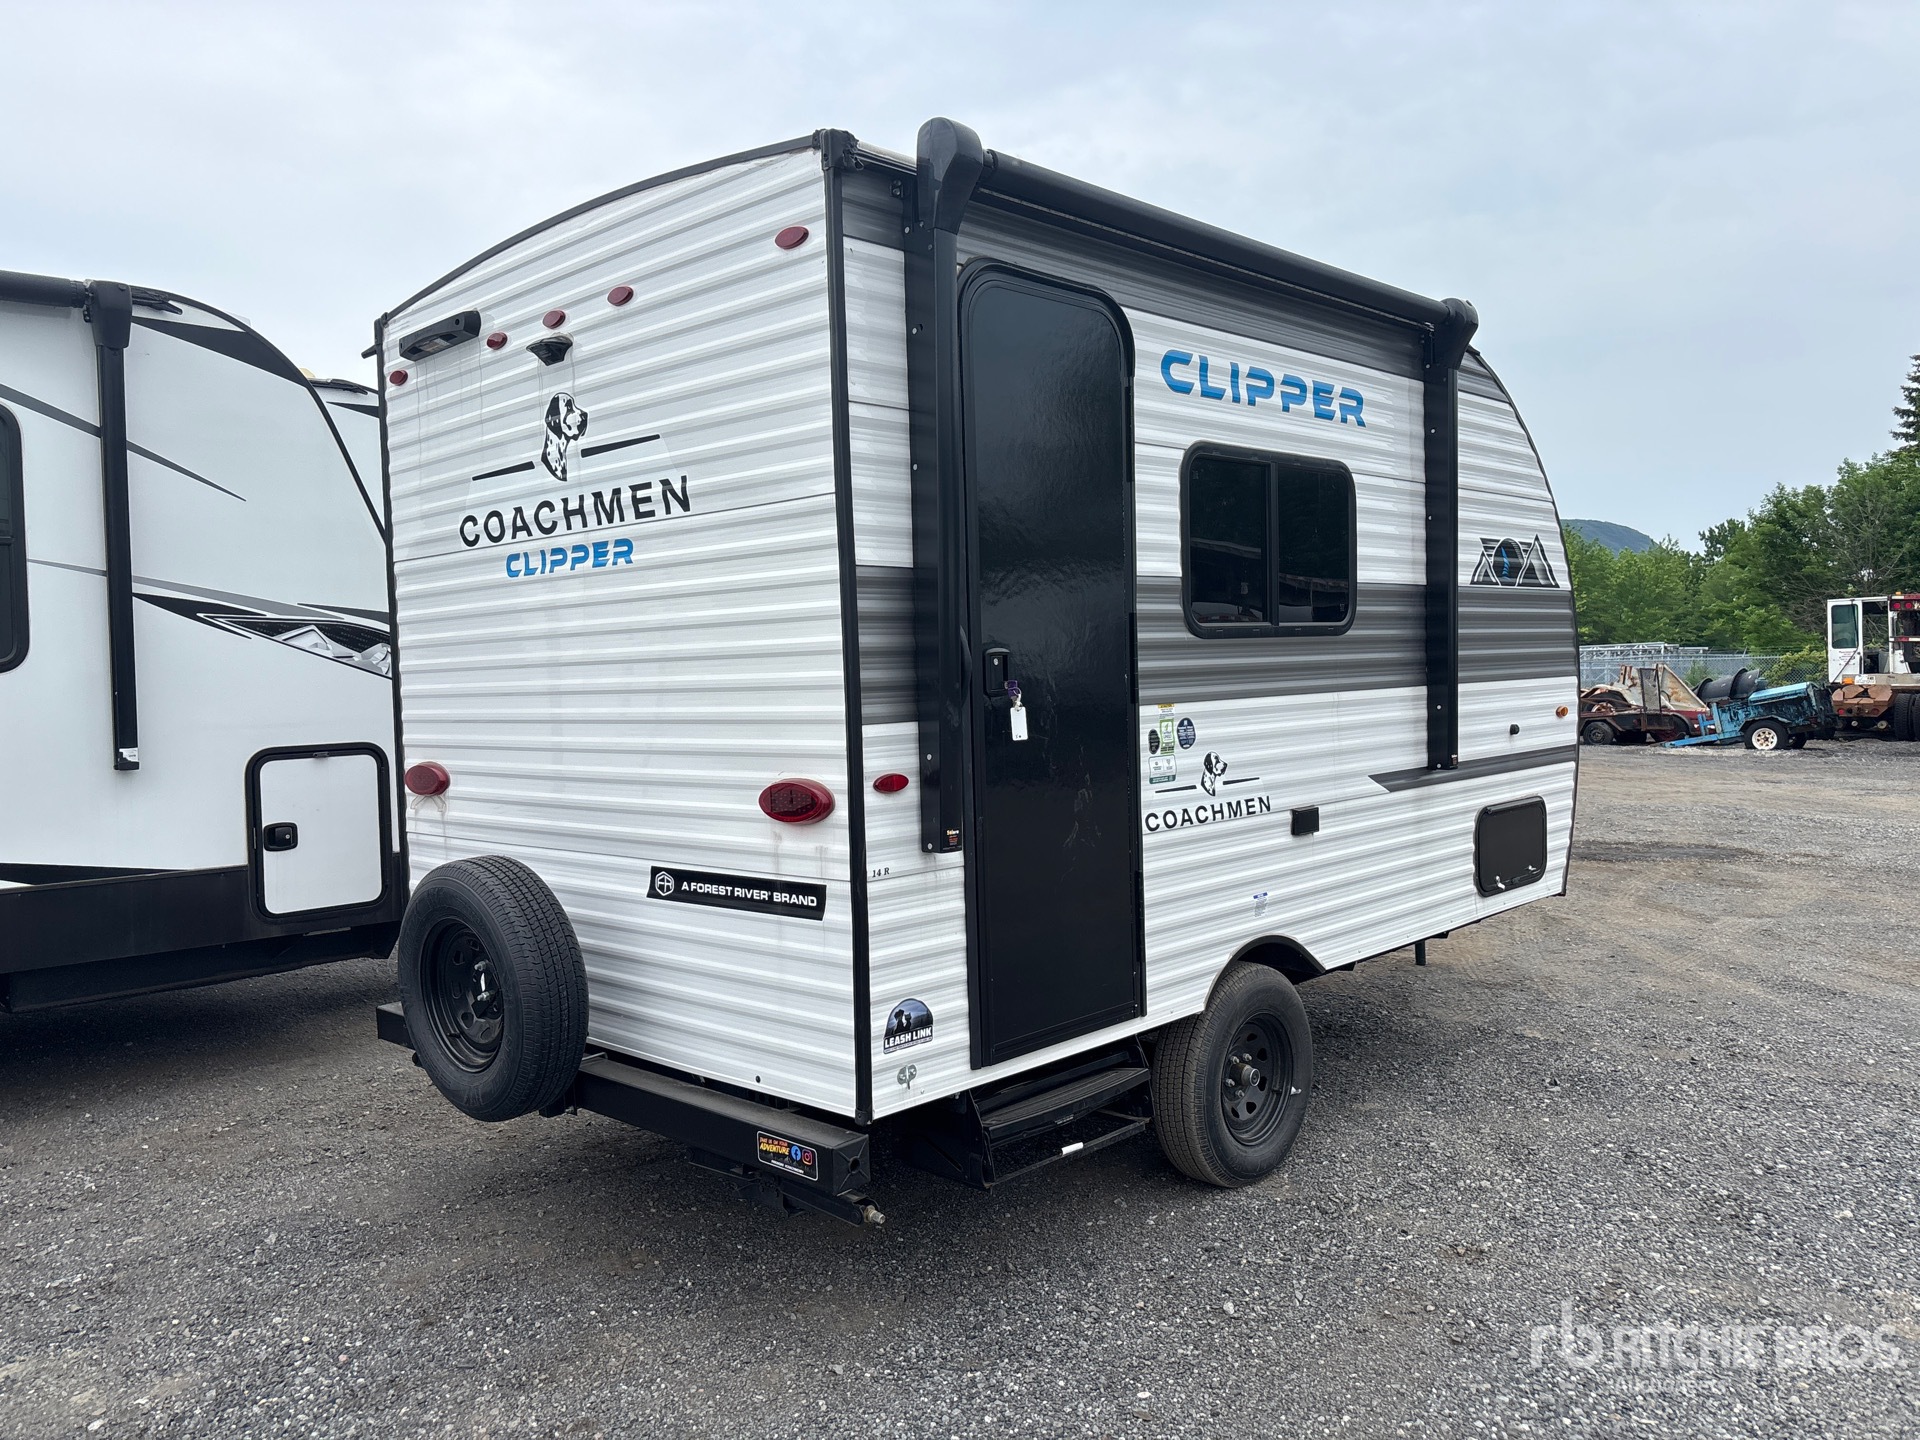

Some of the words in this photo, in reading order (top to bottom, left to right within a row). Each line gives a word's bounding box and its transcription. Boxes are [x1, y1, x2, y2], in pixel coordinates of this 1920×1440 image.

[1160, 349, 1367, 428] CLIPPER
[459, 475, 691, 548] COACHMEN
[506, 538, 634, 578] CLIPPER
[1145, 795, 1271, 832] COACHMEN
[872, 869, 881, 878] 14
[884, 867, 890, 875] R
[681, 881, 689, 891] A
[691, 882, 733, 896] FOREST
[773, 891, 817, 907] BRAND
[884, 1032, 911, 1049] LEASH
[913, 1027, 932, 1040] LINK
[760, 1143, 790, 1155] ADVENTURE
